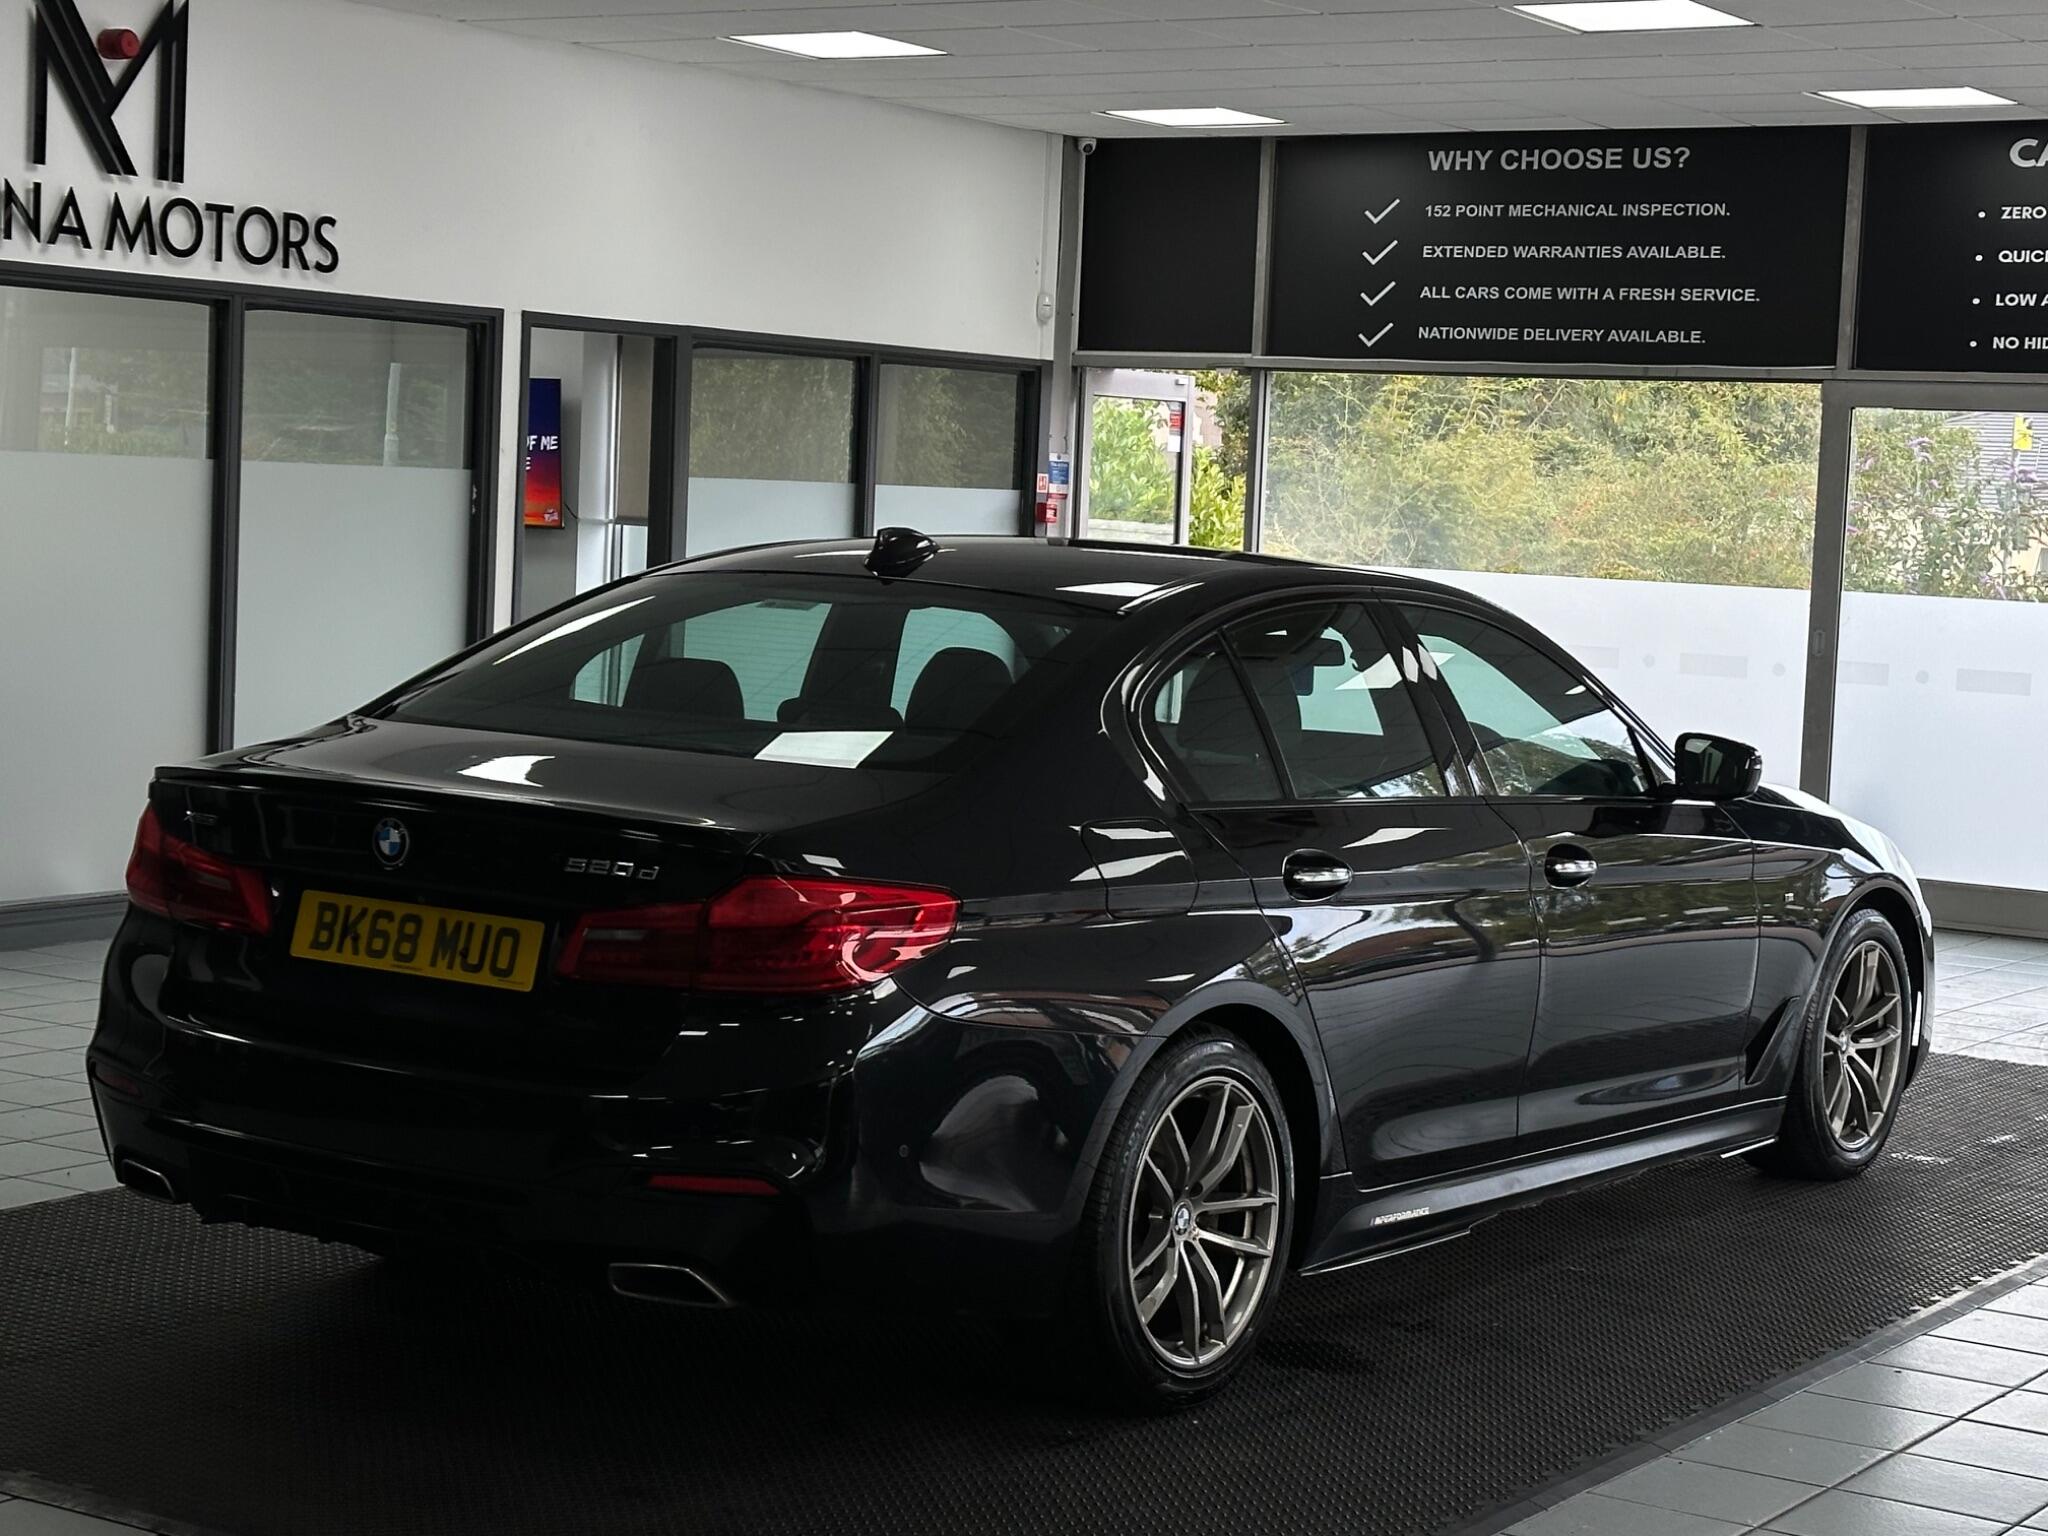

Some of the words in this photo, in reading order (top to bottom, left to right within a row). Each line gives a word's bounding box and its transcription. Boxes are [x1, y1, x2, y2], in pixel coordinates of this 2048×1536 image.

[1428, 150, 1493, 171] WHY
[1500, 148, 1623, 170] CHOOSE
[1632, 147, 1691, 169] US?
[1425, 204, 1451, 217] 152
[1455, 204, 1504, 217] POINT
[1508, 203, 1618, 217] MECHANICAL
[1622, 202, 1731, 217] INSPECTION.
[2000, 206, 2047, 220] ZERO
[3, 178, 92, 250] NA
[104, 192, 339, 273] MOTORS
[1422, 245, 1509, 259] EXTENDED
[1513, 245, 1623, 259] WARRANTIES
[1626, 245, 1726, 259] AVAILABLE.
[1998, 249, 2048, 263] QUIC
[1419, 286, 1451, 299] ALL
[1454, 286, 1500, 300] CARS
[1504, 286, 1552, 300] COME
[1556, 287, 1599, 301] WITH
[1602, 287, 1615, 301] A
[1618, 287, 1676, 301] FRESH
[1679, 288, 1760, 302] SERVICE.
[1995, 293, 2037, 307] LOW
[1418, 327, 1519, 341] NATIONWIDE
[1523, 328, 1604, 342] DELIVERY
[1607, 329, 1706, 344] AVAILABLE.
[1992, 336, 2020, 350] NO
[540, 435, 559, 451] ME
[309, 901, 422, 963] BK68
[429, 918, 521, 978] MUO
